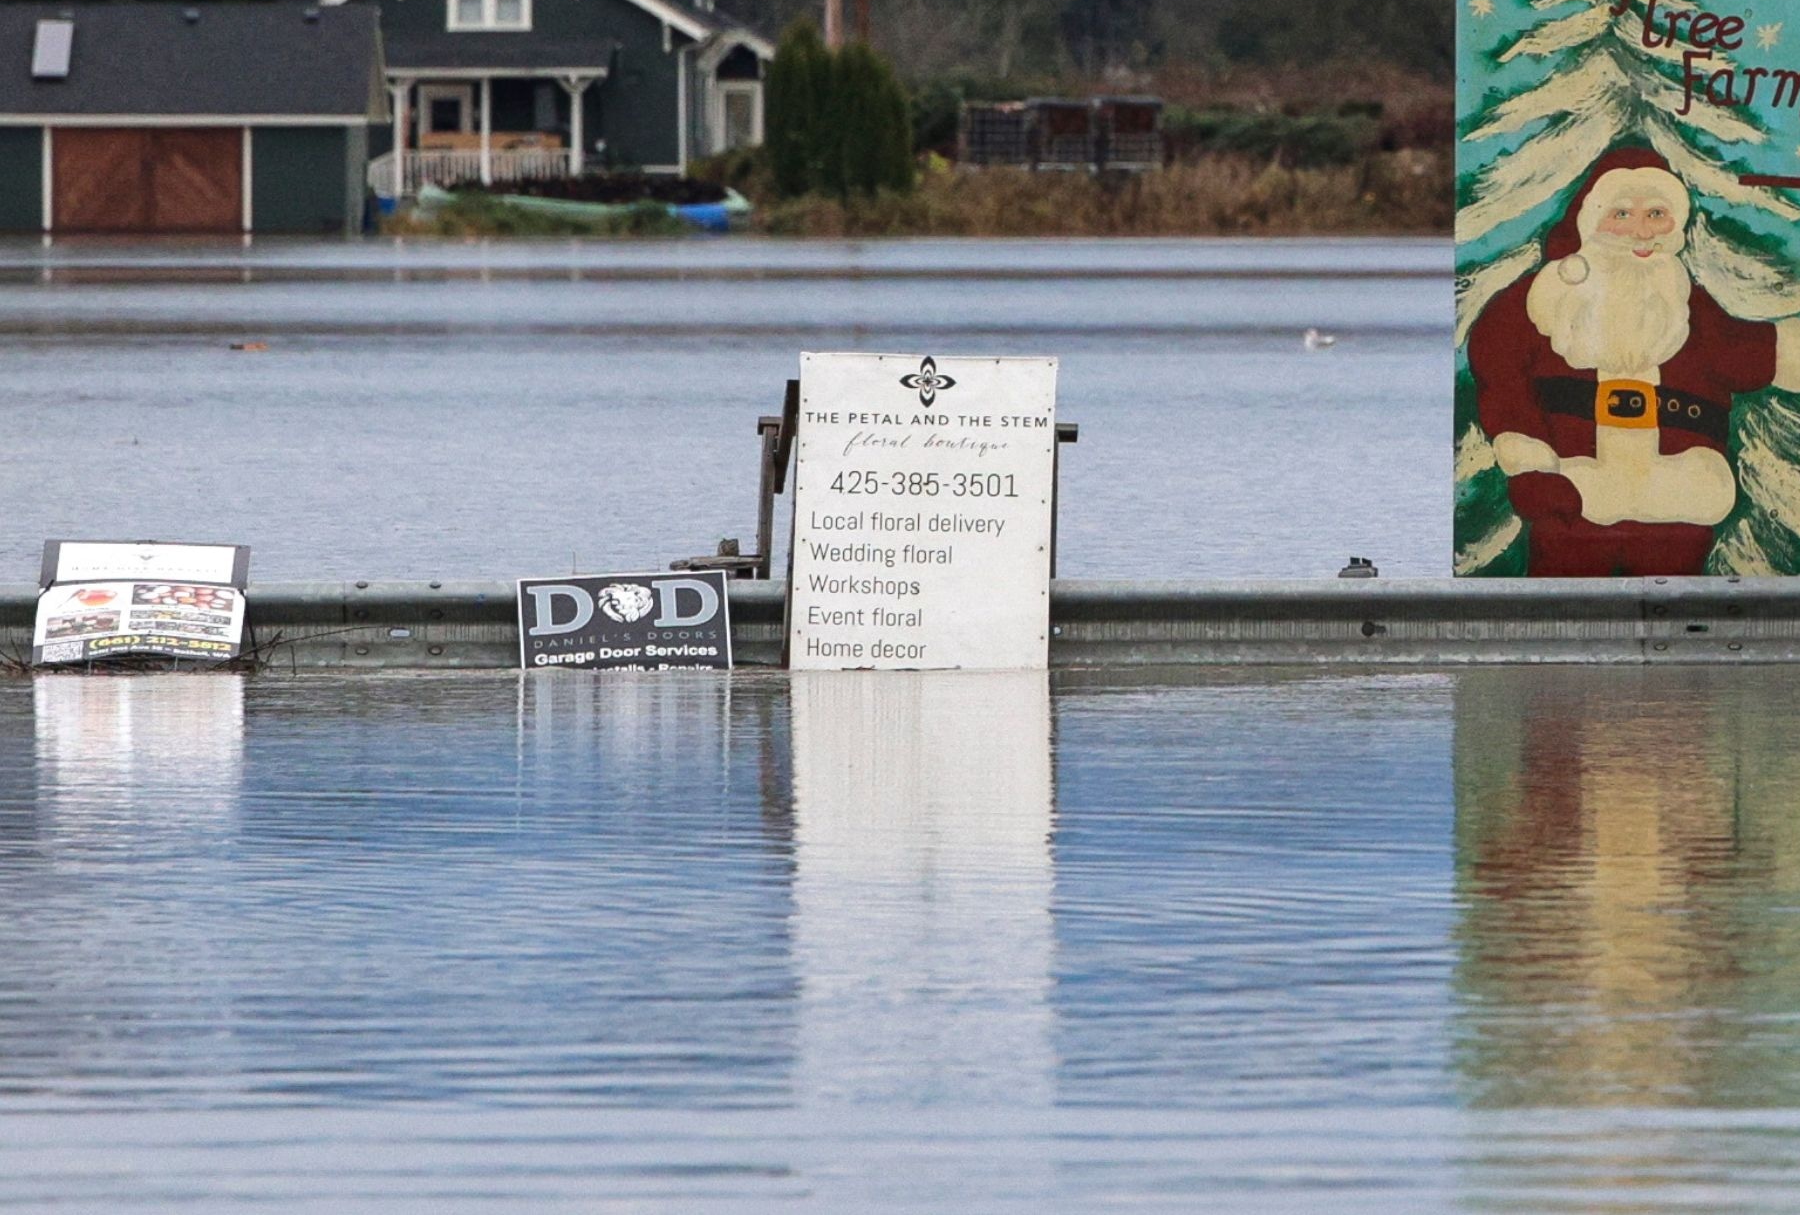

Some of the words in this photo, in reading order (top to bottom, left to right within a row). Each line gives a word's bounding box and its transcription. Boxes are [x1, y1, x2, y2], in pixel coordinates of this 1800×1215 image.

[805, 412, 840, 424] THE
[849, 412, 903, 426] PETAL
[911, 414, 949, 427] AND
[958, 415, 992, 427] THE
[1001, 416, 1048, 428] STEM
[843, 431, 911, 457] floral
[922, 433, 1009, 457] boutique
[830, 470, 1019, 498] 425-385-3501
[810, 510, 864, 531] Local
[871, 511, 921, 532] floral
[928, 513, 1006, 538] delivery
[809, 542, 896, 568] Wedding
[903, 544, 953, 565] floral
[808, 574, 921, 600] Workshops
[808, 606, 864, 626] Event
[871, 607, 923, 627] floral
[534, 633, 631, 649] DANIEL'S
[647, 630, 717, 641] DOORS
[806, 638, 864, 658] Home
[870, 639, 927, 660] decor
[534, 649, 595, 666] Garage
[599, 646, 641, 660] Door
[645, 643, 718, 657] Services
